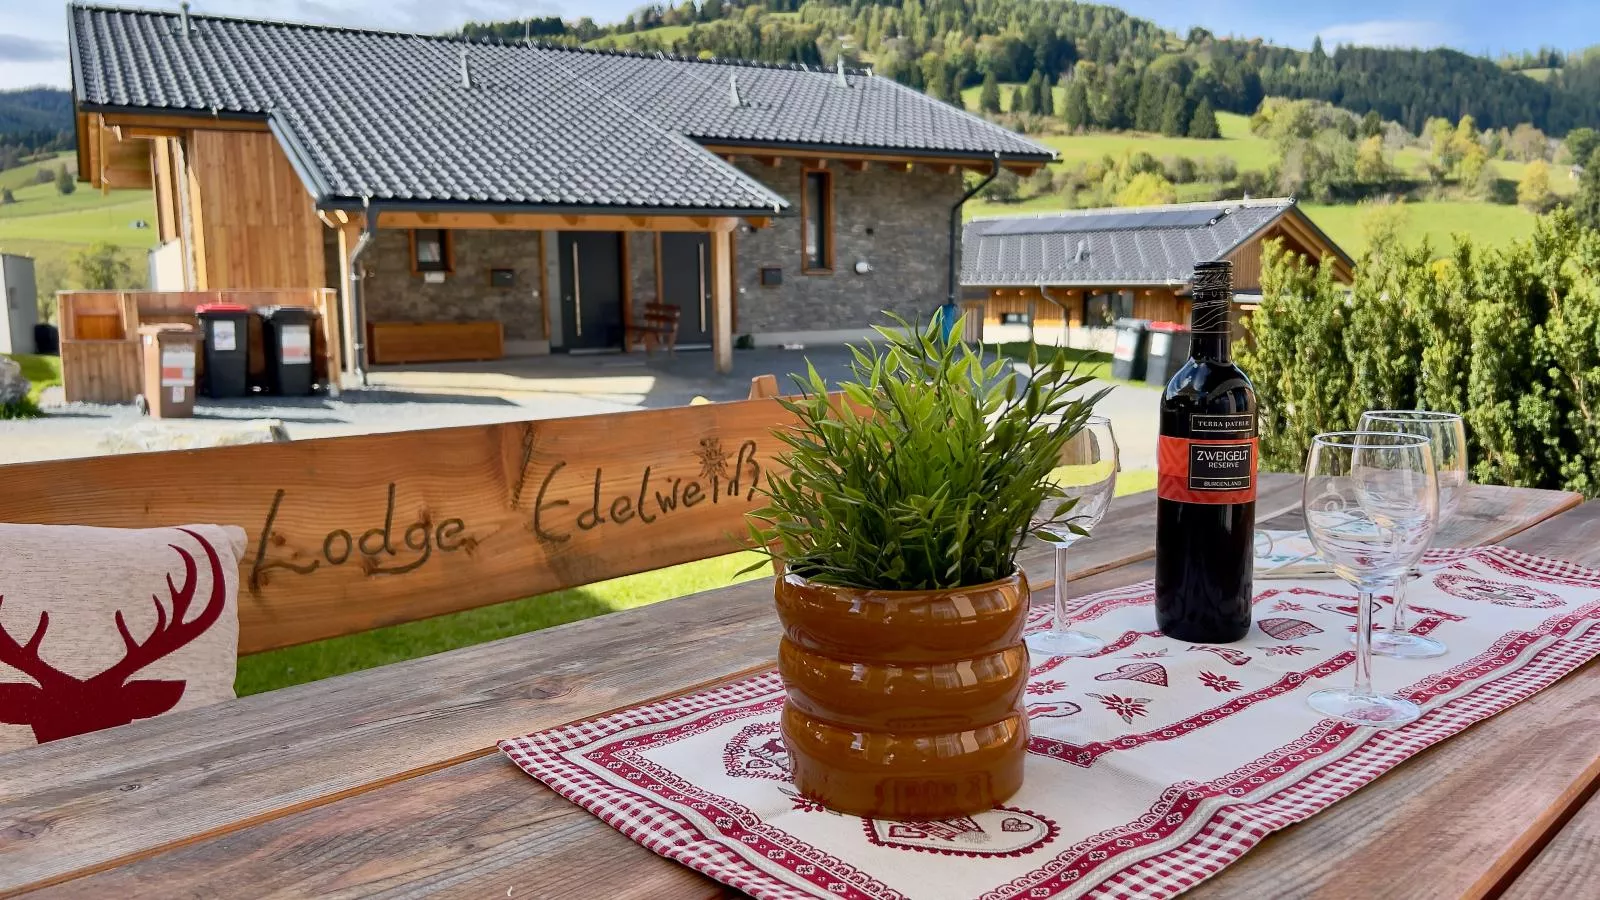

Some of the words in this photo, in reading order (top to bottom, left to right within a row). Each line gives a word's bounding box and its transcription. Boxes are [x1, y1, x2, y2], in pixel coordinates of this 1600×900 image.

[1196, 450, 1248, 461] ZWEIGELT
[1208, 461, 1240, 469] RESERVE
[247, 482, 470, 594] Lodge
[534, 439, 760, 543] Edelweiß
